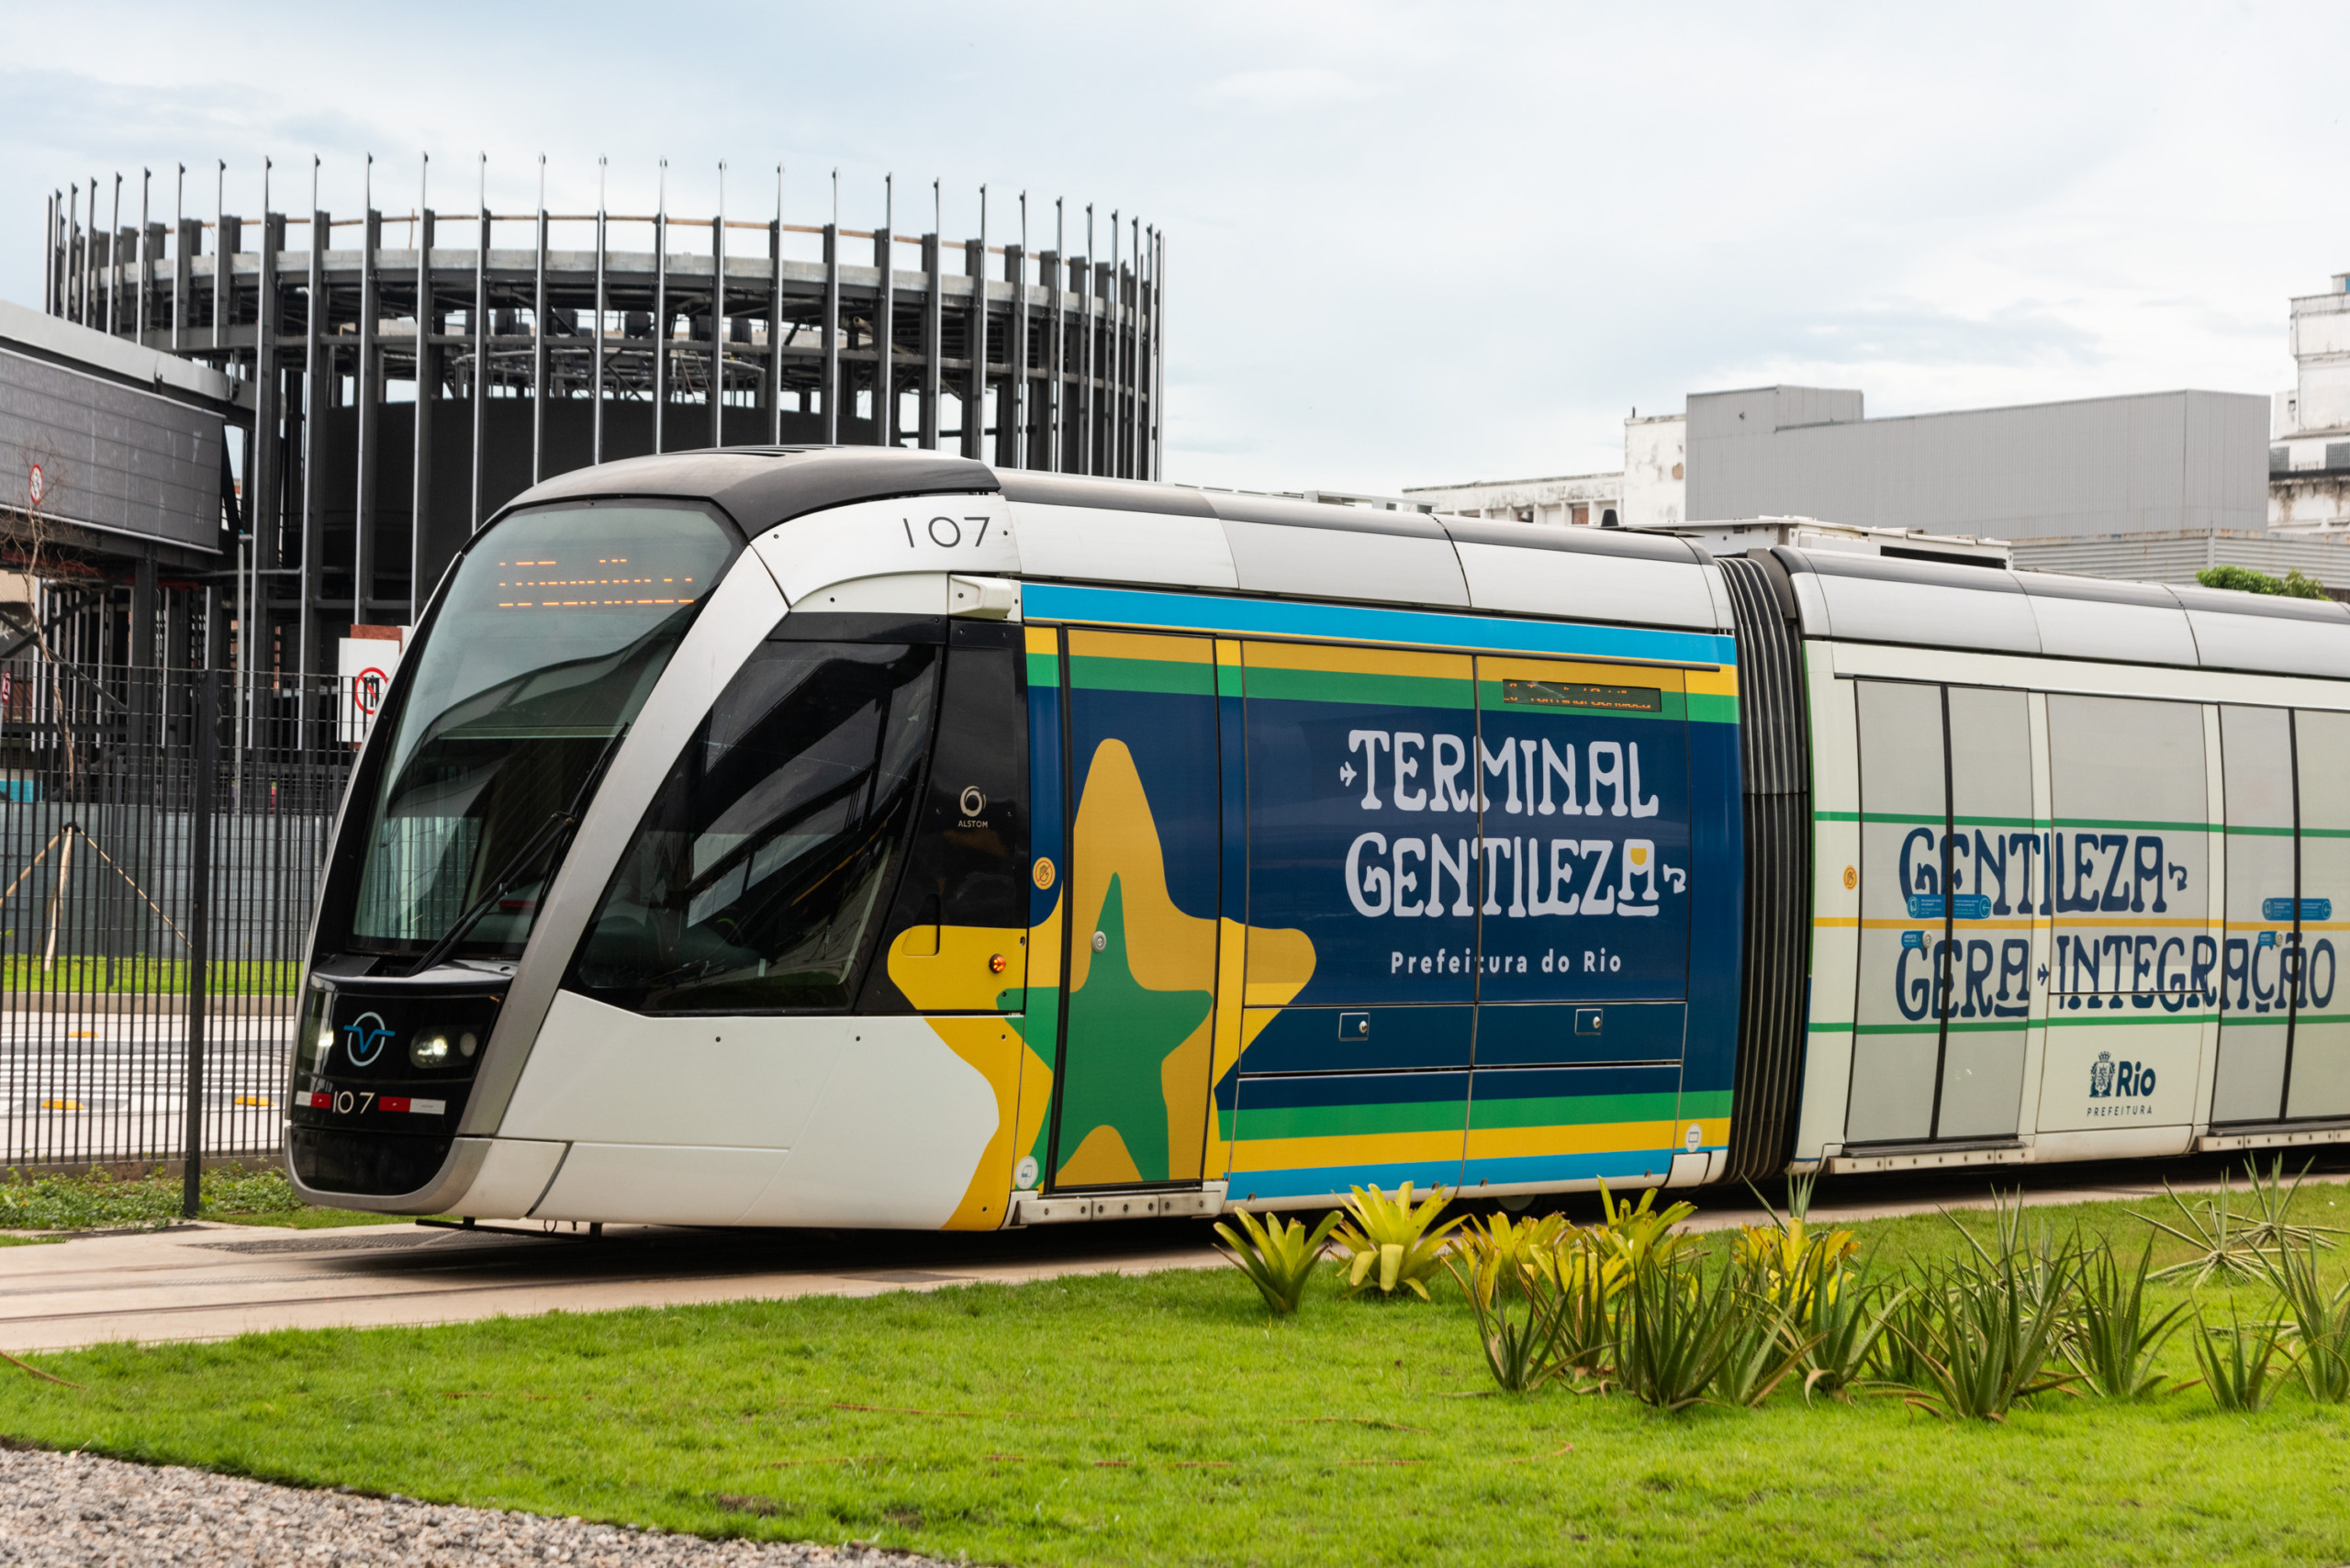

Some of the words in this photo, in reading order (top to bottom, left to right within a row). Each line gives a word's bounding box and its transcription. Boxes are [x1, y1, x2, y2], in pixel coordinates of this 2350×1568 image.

[902, 516, 990, 548] 107
[1348, 729, 1659, 818] TERMINAL
[957, 820, 989, 828] ALSTOM
[1345, 832, 1659, 917] GENTILEZA
[1899, 827, 2167, 915] GENTILEZA
[1541, 948, 1570, 973] do
[1583, 946, 1622, 973] Rio
[1896, 938, 2030, 1021] GERA
[2056, 932, 2336, 1014] INTEGRAÇÃO
[2115, 1060, 2156, 1097] Rio
[332, 1090, 375, 1114] 107
[2087, 1104, 2153, 1117] PREFEITURA
